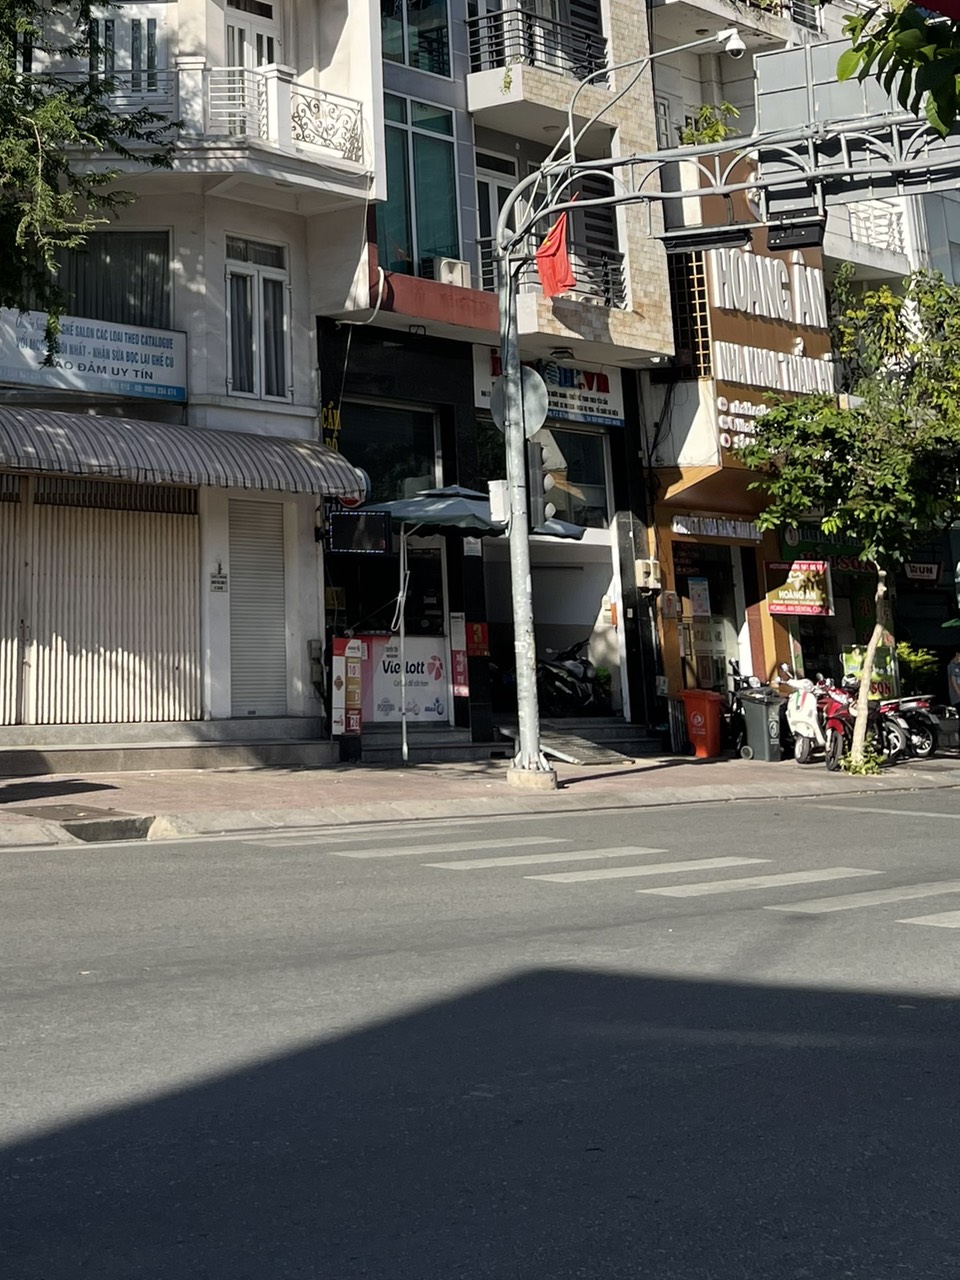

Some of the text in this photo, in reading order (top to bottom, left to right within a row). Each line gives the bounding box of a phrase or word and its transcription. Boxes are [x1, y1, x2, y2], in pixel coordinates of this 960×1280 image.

[710, 242, 828, 328] HOÀNG ÂN
[75, 324, 94, 339] SALON
[95, 325, 109, 341] CÁC
[124, 332, 139, 345] THEO
[141, 333, 173, 349] CATALOGUE
[77, 360, 107, 375] ĐẢM
[111, 368, 129, 377] UY
[132, 367, 153, 380] TÍN
[714, 341, 744, 382] NHA
[744, 346, 779, 389] KHOA
[382, 659, 425, 674] Vielott
